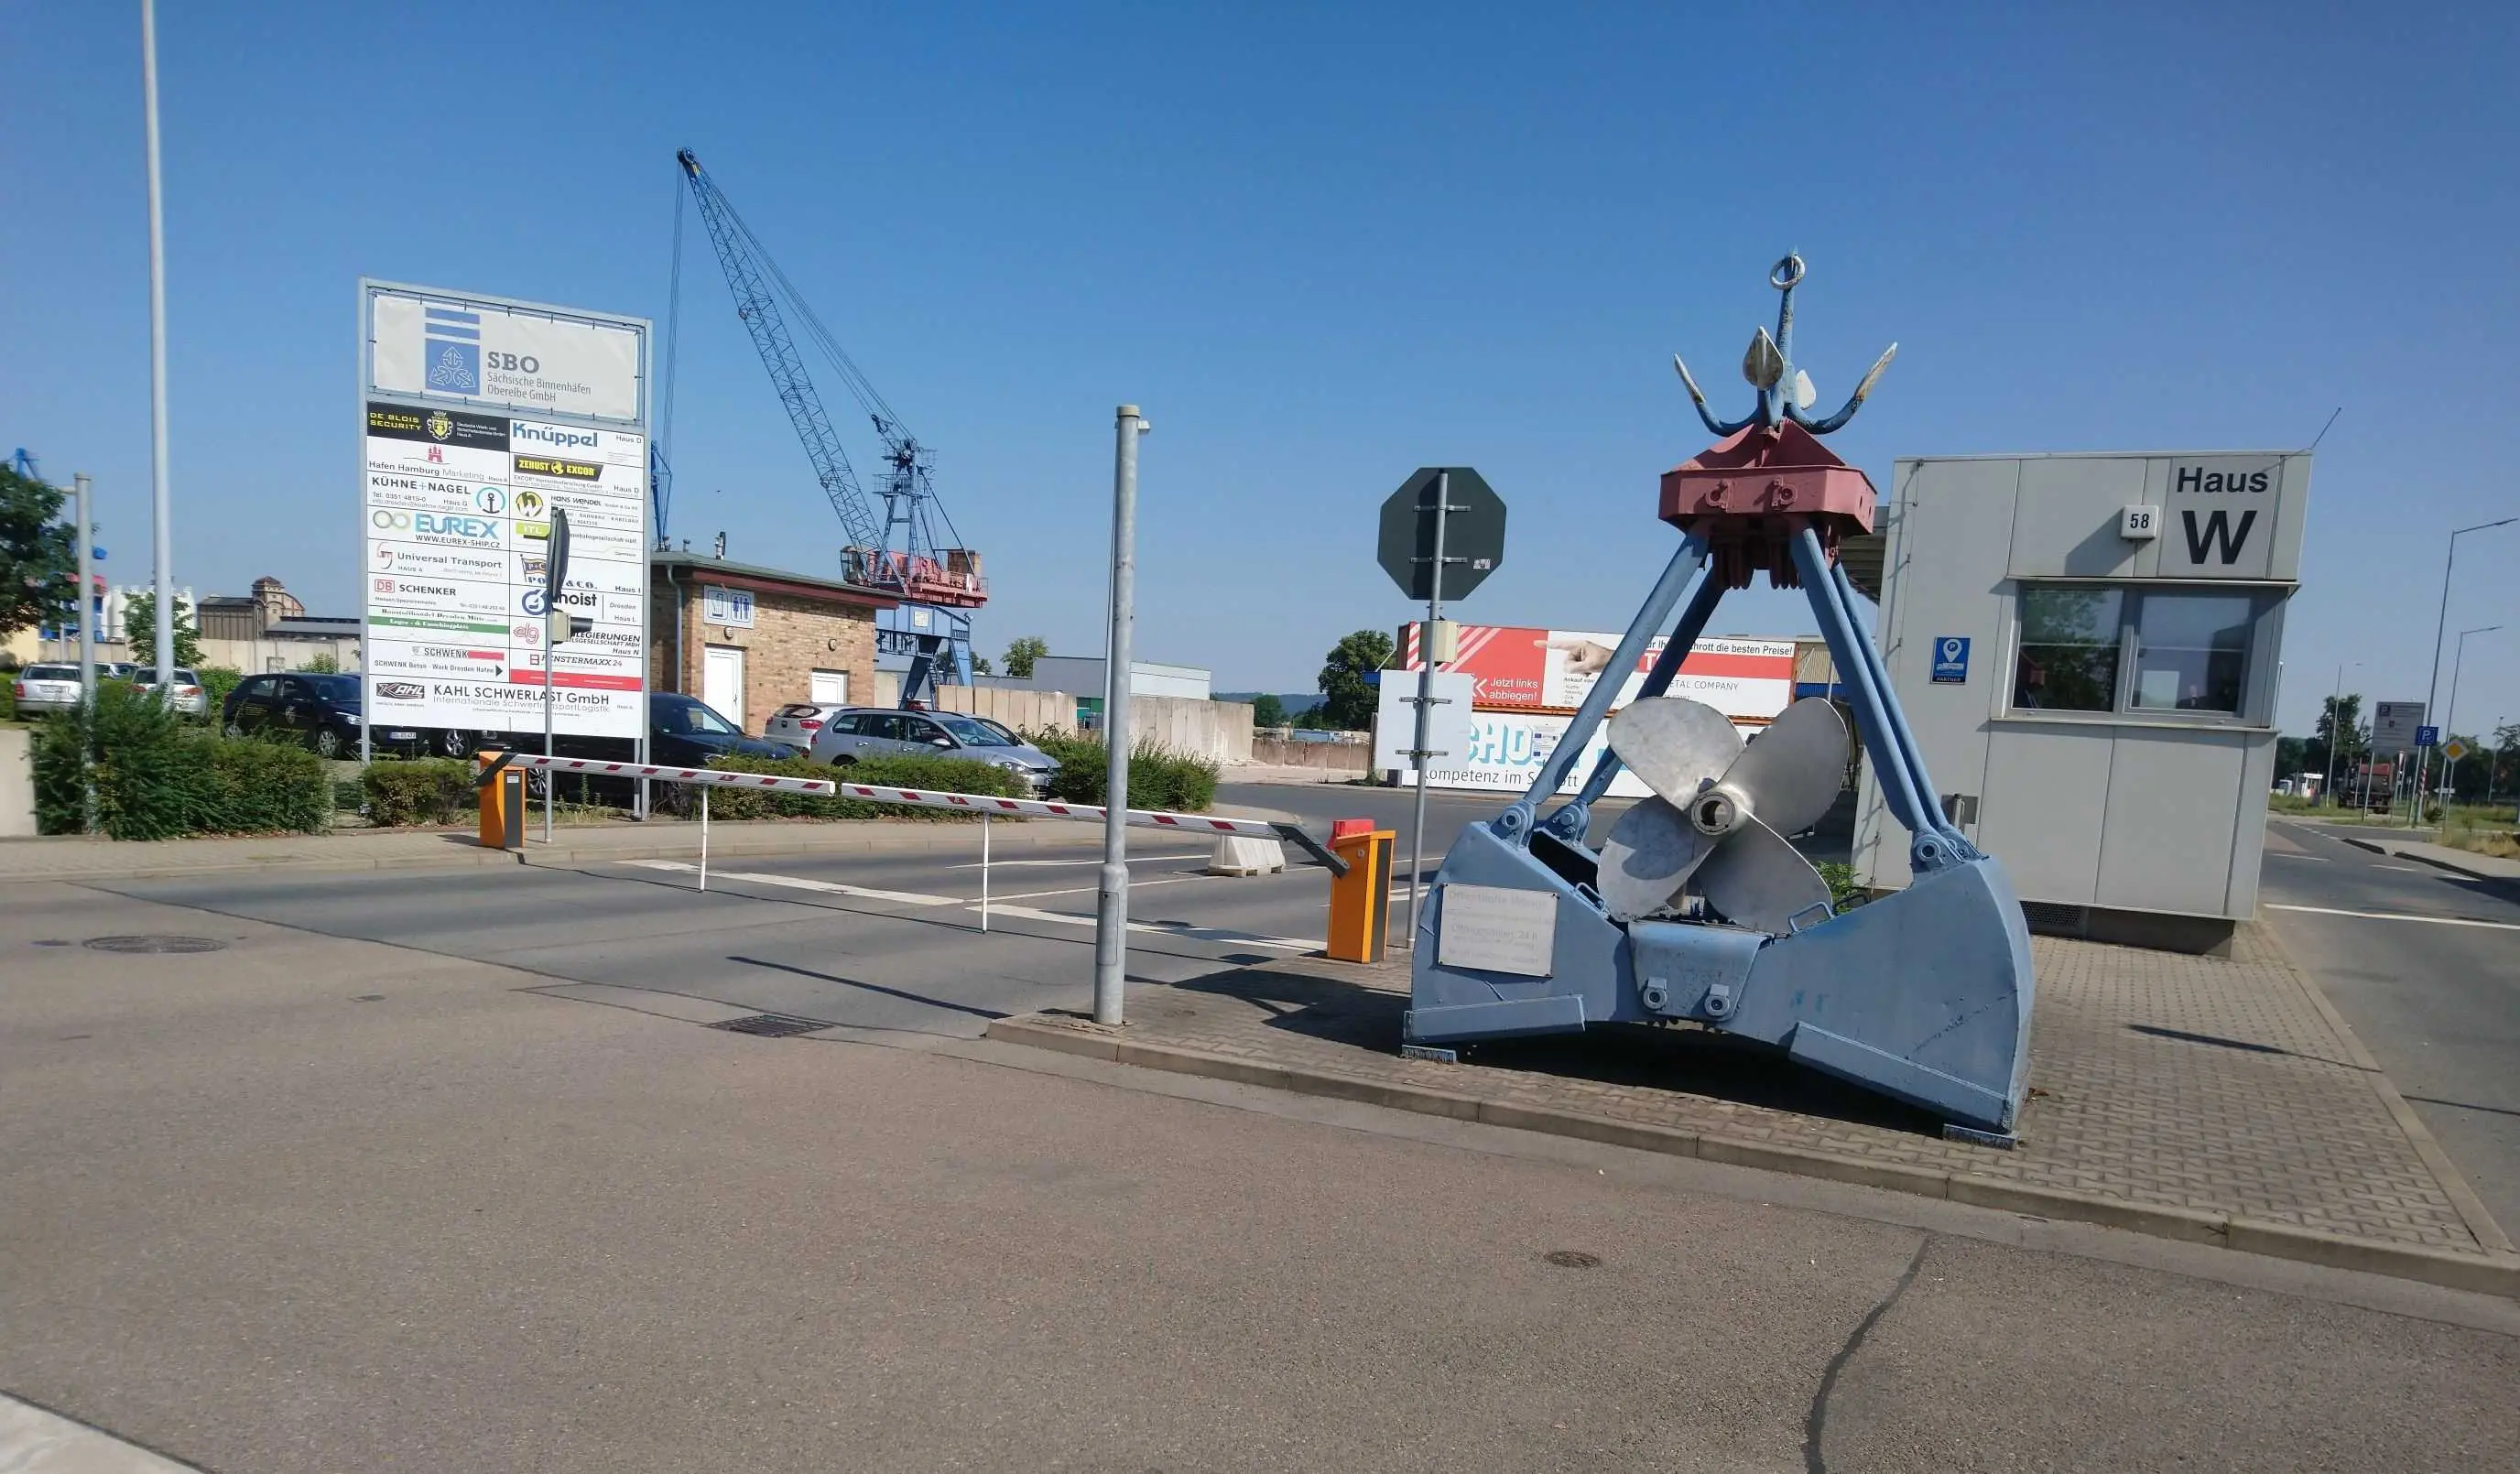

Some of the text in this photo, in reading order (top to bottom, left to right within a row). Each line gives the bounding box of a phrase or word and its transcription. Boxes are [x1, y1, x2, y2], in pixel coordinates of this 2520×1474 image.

[488, 352, 539, 374] SBO
[487, 372, 591, 395] Sächsische Binnenhäfen
[488, 385, 556, 402] Oberelbe GmbH
[370, 420, 422, 430] SECURITY
[388, 415, 419, 423] BLOIS
[513, 422, 598, 448] Knüppel
[615, 435, 635, 443] Haus
[369, 461, 395, 471] Hafen
[397, 463, 440, 476] Hamburg
[442, 469, 484, 481] Marketing
[566, 465, 595, 476] EXCOR
[2177, 467, 2269, 493] Haus
[614, 484, 632, 493] Haus
[416, 513, 499, 539] EUREX
[2130, 513, 2150, 529] 58
[523, 526, 543, 535] ITL
[416, 535, 500, 548] WWW.EUREX-SHIP.CZ
[2181, 510, 2258, 565] W
[397, 552, 503, 569] Universal Transport
[376, 580, 456, 596] DB SCHENKER
[574, 632, 640, 643] LEGIERUNGEN
[424, 648, 468, 658] SCHWENK
[1716, 643, 1729, 652] die
[1732, 644, 1761, 654] besten
[1763, 645, 1793, 656] Preise!
[541, 655, 612, 667] FNSTERMAXX
[1490, 677, 1538, 688] Jetzt links
[1669, 680, 1739, 691] ETAL COMPANY
[378, 682, 424, 698] KAHL
[434, 685, 470, 697] KAHL
[566, 692, 609, 704] GmbH
[1489, 690, 1537, 702] abbiegen!
[433, 697, 500, 706] Internationale
[1504, 773, 1521, 784] im
